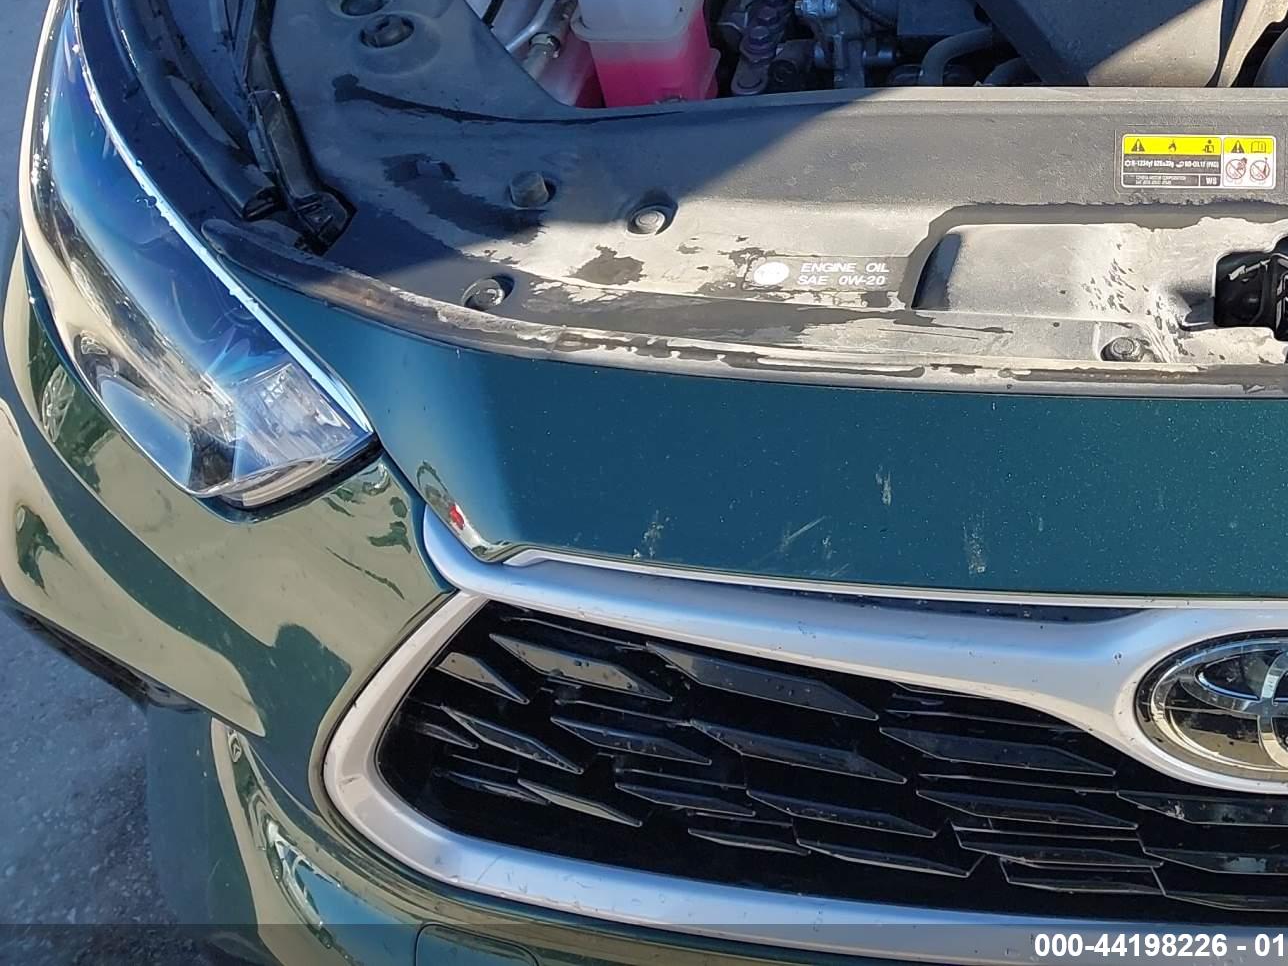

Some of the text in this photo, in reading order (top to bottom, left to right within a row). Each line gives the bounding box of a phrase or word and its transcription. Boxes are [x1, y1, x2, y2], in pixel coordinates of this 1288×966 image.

[800, 262, 890, 273] ENGINE OIL
[796, 275, 887, 286] SAE 0W-20
